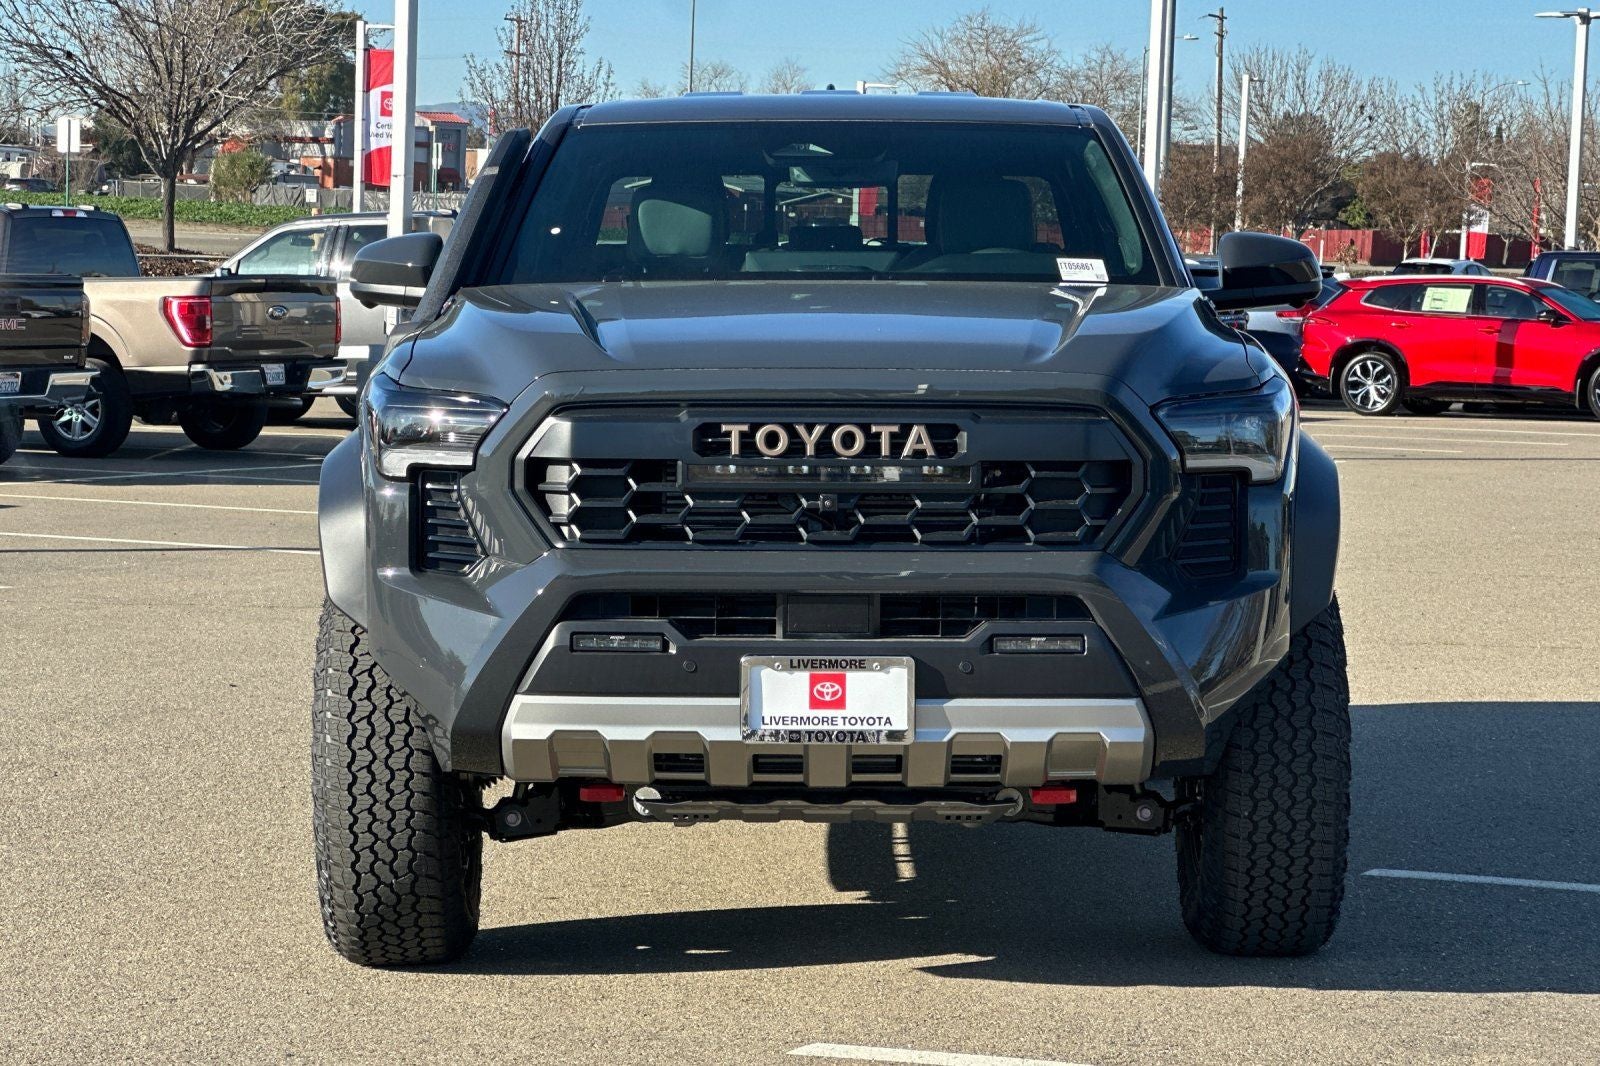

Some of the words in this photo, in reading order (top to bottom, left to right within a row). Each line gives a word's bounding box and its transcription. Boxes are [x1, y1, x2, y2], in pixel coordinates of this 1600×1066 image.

[376, 122, 392, 130] Certi
[720, 424, 937, 459] TOYOTA
[789, 658, 867, 670] LIVERMORE
[762, 716, 838, 726] LIVERMORE
[842, 716, 893, 727] TOYOTA
[804, 731, 868, 743] TOYOTA
